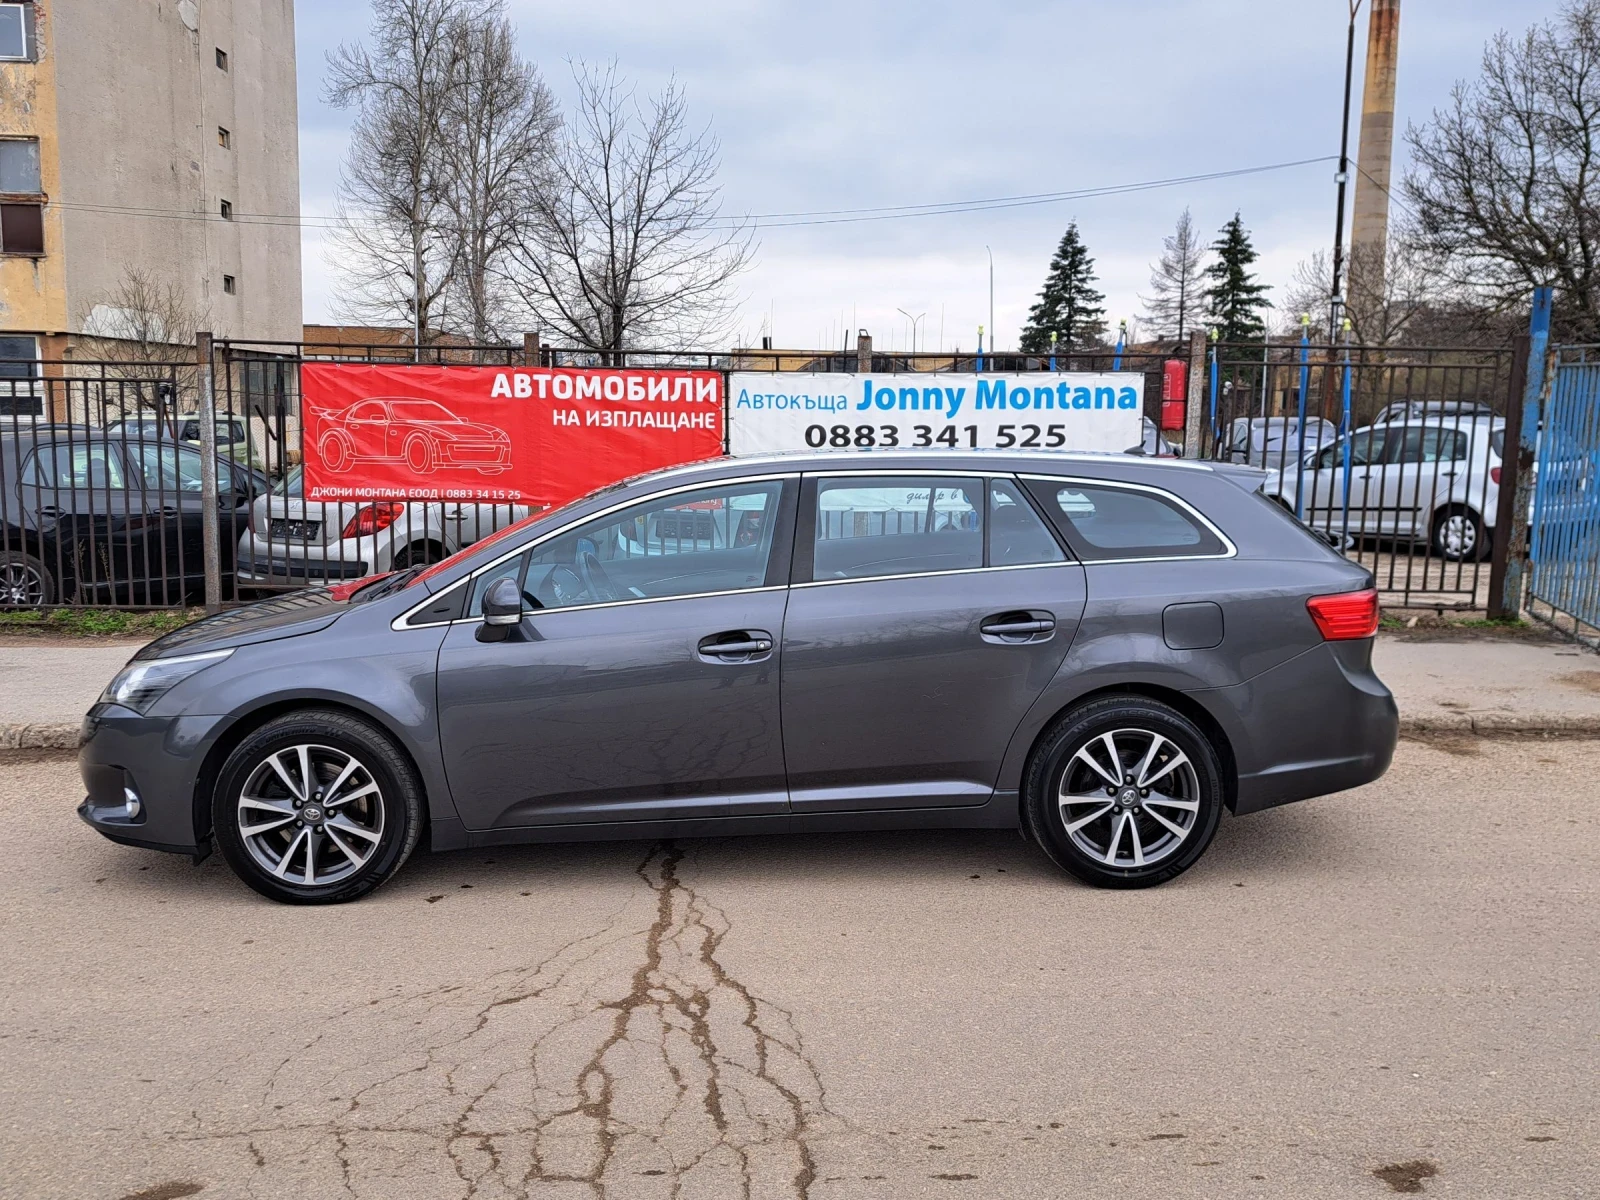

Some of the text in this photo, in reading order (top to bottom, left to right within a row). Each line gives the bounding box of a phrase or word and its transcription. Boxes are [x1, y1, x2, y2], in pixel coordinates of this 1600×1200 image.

[491, 373, 718, 402] АВТОМОБИЛИ
[736, 388, 848, 414] Автокъща
[855, 379, 968, 420] Jonny
[974, 379, 1138, 411] Montana
[553, 409, 716, 432] НА ИЗПЛАЩАНЕ
[804, 424, 1066, 448] 0883 341 525
[310, 486, 353, 498] ДЖОНИ
[355, 487, 406, 498] МОНТАНА
[408, 488, 438, 499] ЕООД
[446, 489, 473, 499] 0883
[476, 489, 490, 499] 34
[492, 489, 506, 499] 15
[507, 490, 521, 500] 25
